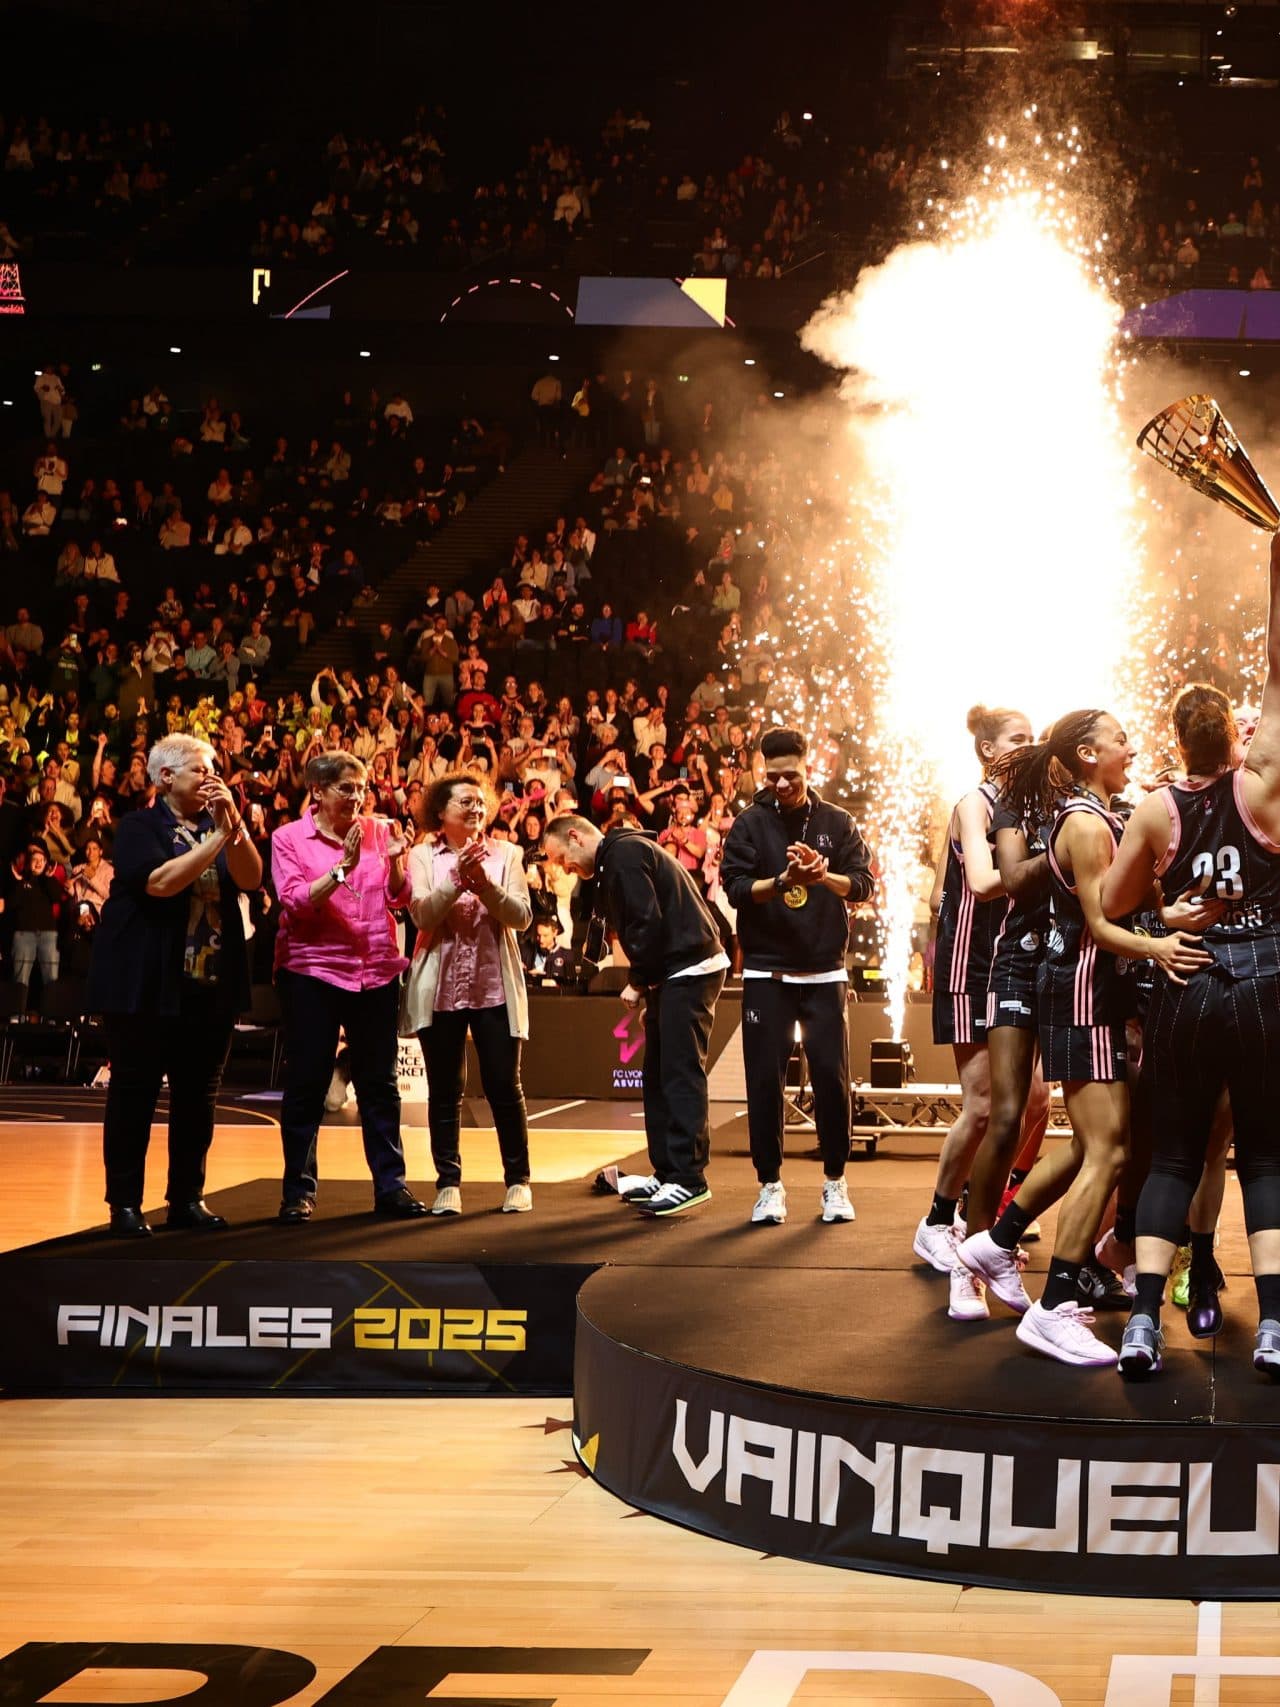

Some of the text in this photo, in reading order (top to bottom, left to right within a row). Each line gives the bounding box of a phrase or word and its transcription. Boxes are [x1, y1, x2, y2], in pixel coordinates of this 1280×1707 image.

[1191, 845, 1244, 904] 23
[396, 1067, 424, 1077] SKET
[57, 1304, 528, 1352] FINALES 2025
